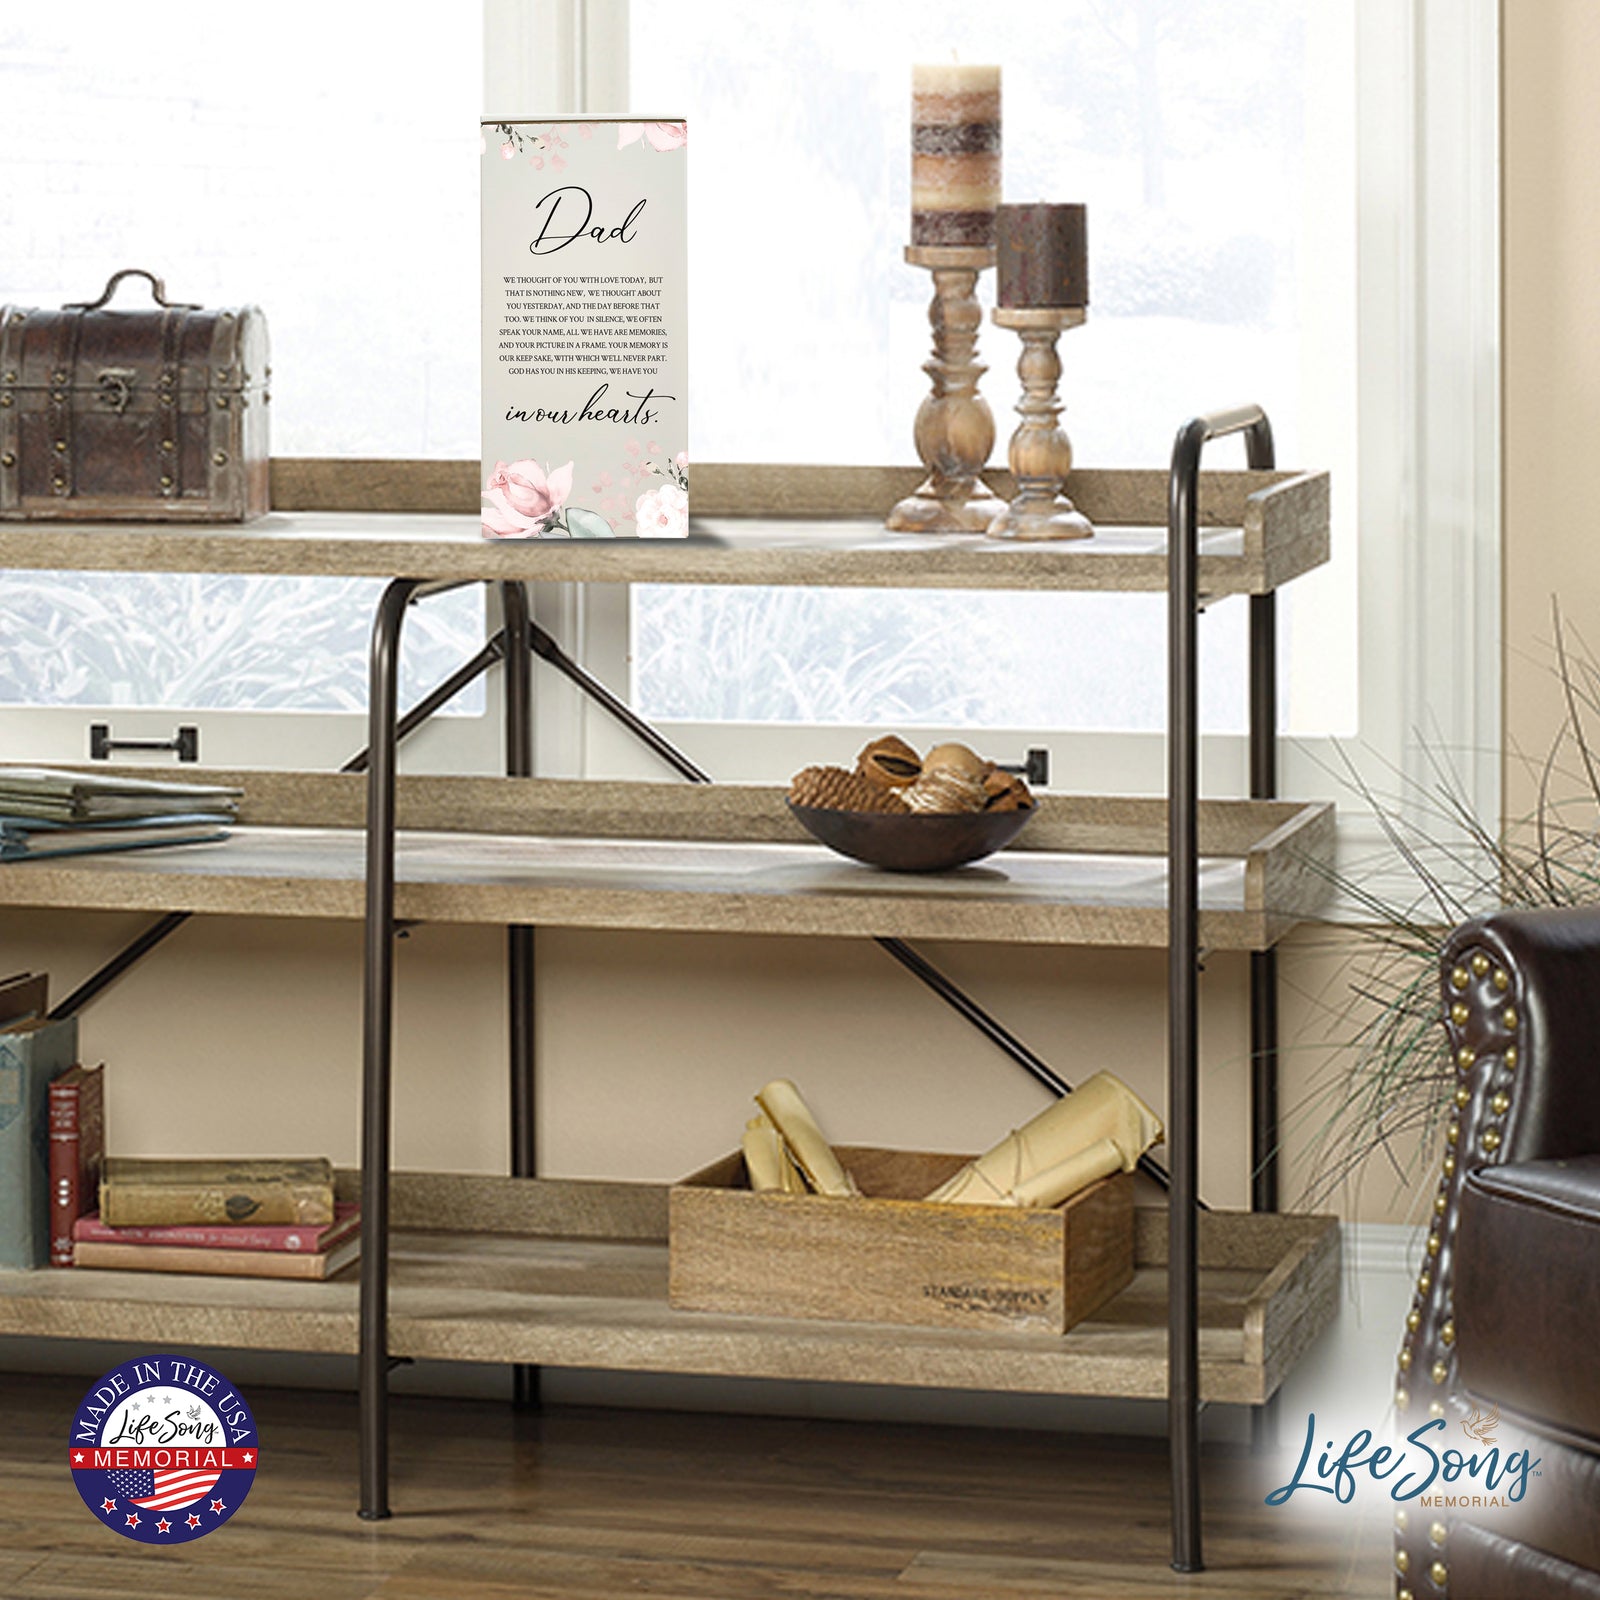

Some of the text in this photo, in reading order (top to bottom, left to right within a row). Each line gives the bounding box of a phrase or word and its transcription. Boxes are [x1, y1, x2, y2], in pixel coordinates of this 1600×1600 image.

[530, 186, 646, 255] Dad
[619, 277, 647, 285] TODAY,
[566, 290, 586, 298] NEW,
[522, 303, 565, 311] YESTERDAY,
[595, 316, 625, 324] SILENCE,
[542, 329, 566, 337] NAME,
[628, 329, 668, 337] MEMORIES,
[533, 355, 553, 363] SAKE,
[577, 368, 609, 376] KEEPING,
[506, 383, 676, 424] in our hearts.
